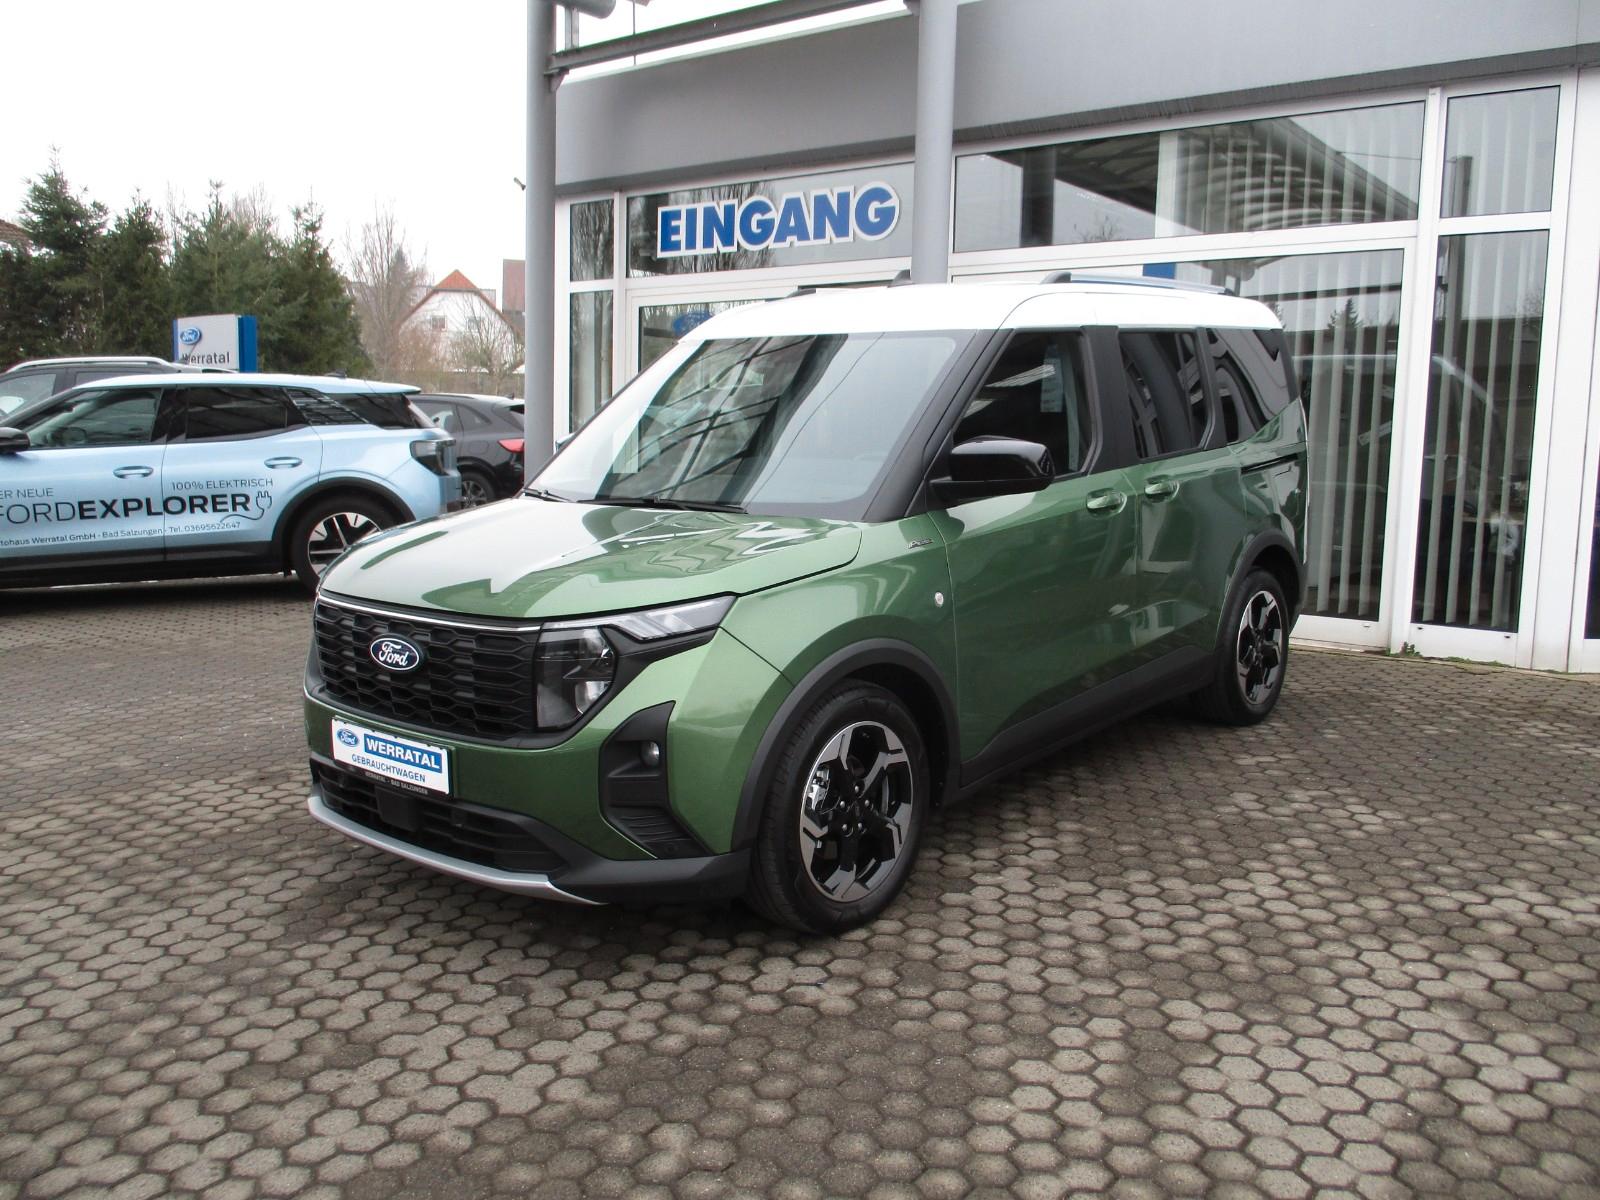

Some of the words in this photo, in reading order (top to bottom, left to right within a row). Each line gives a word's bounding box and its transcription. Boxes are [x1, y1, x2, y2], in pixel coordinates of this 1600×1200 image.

[659, 186, 897, 254] EINGANG
[182, 351, 230, 365] Werratal
[17, 487, 54, 498] NEUE
[172, 481, 204, 491] 100%
[206, 478, 274, 489] ELEKTRISCH
[0, 493, 250, 525] ORDEXPLORER
[31, 535, 68, 544] Werratal
[69, 533, 96, 541] GmbH
[102, 530, 119, 539] Bad
[120, 527, 163, 537] Salzungen
[378, 641, 409, 666] Ford
[366, 737, 440, 769] WERRATAL
[351, 753, 426, 783] GEBRAUCHTWAGEN
